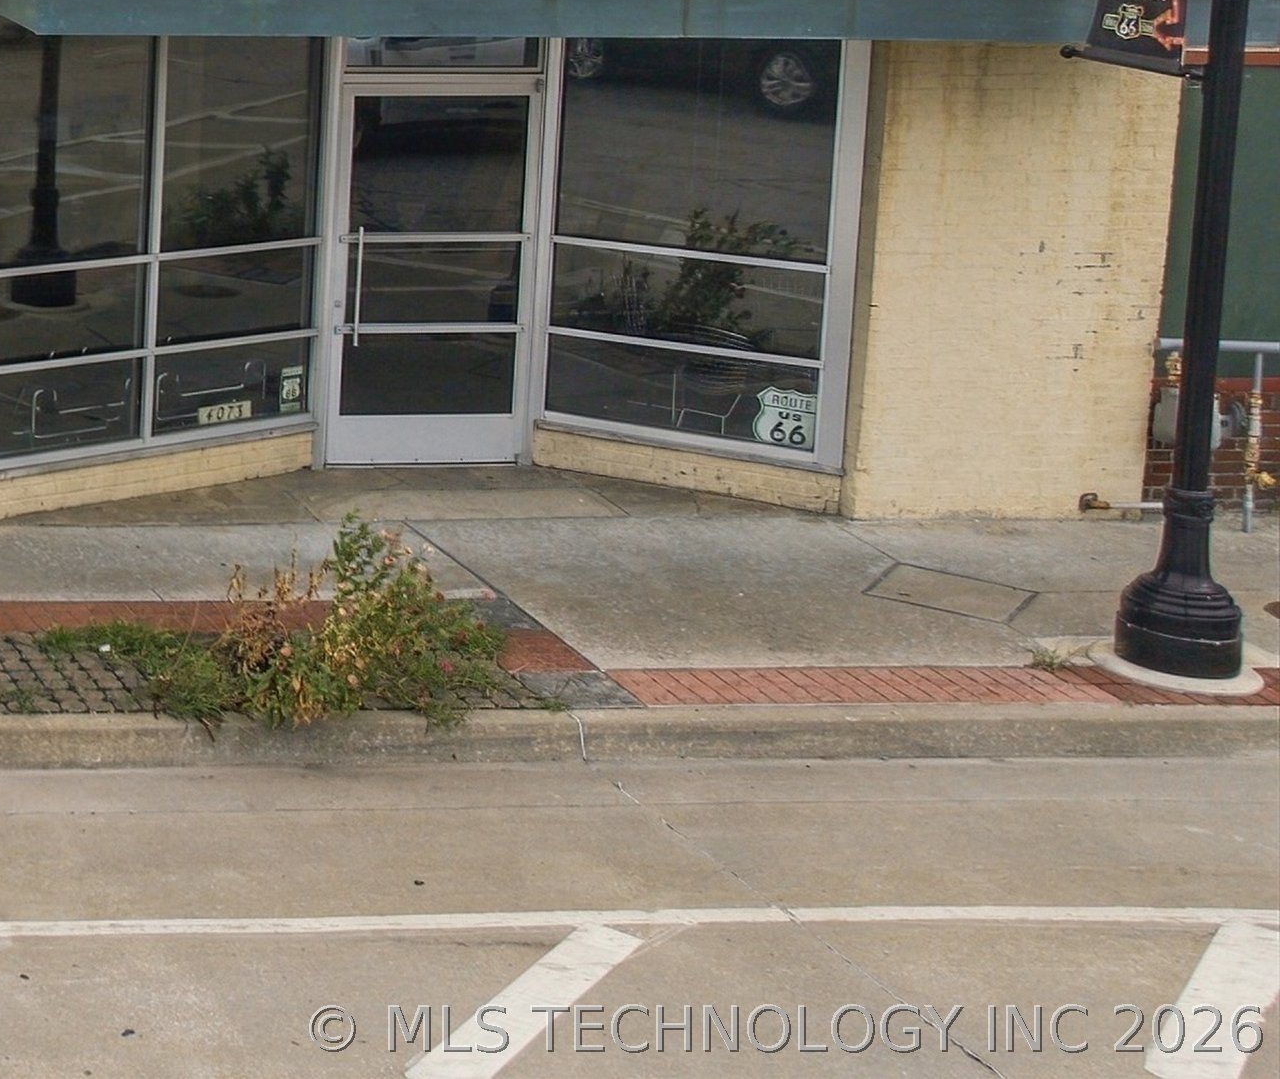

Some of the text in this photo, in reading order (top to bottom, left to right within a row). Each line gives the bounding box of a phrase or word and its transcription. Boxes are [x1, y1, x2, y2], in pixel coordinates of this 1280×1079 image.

[1120, 18, 1136, 35] 66
[771, 394, 812, 410] ROUTE
[206, 405, 244, 421] 4073
[770, 422, 806, 445] 66
